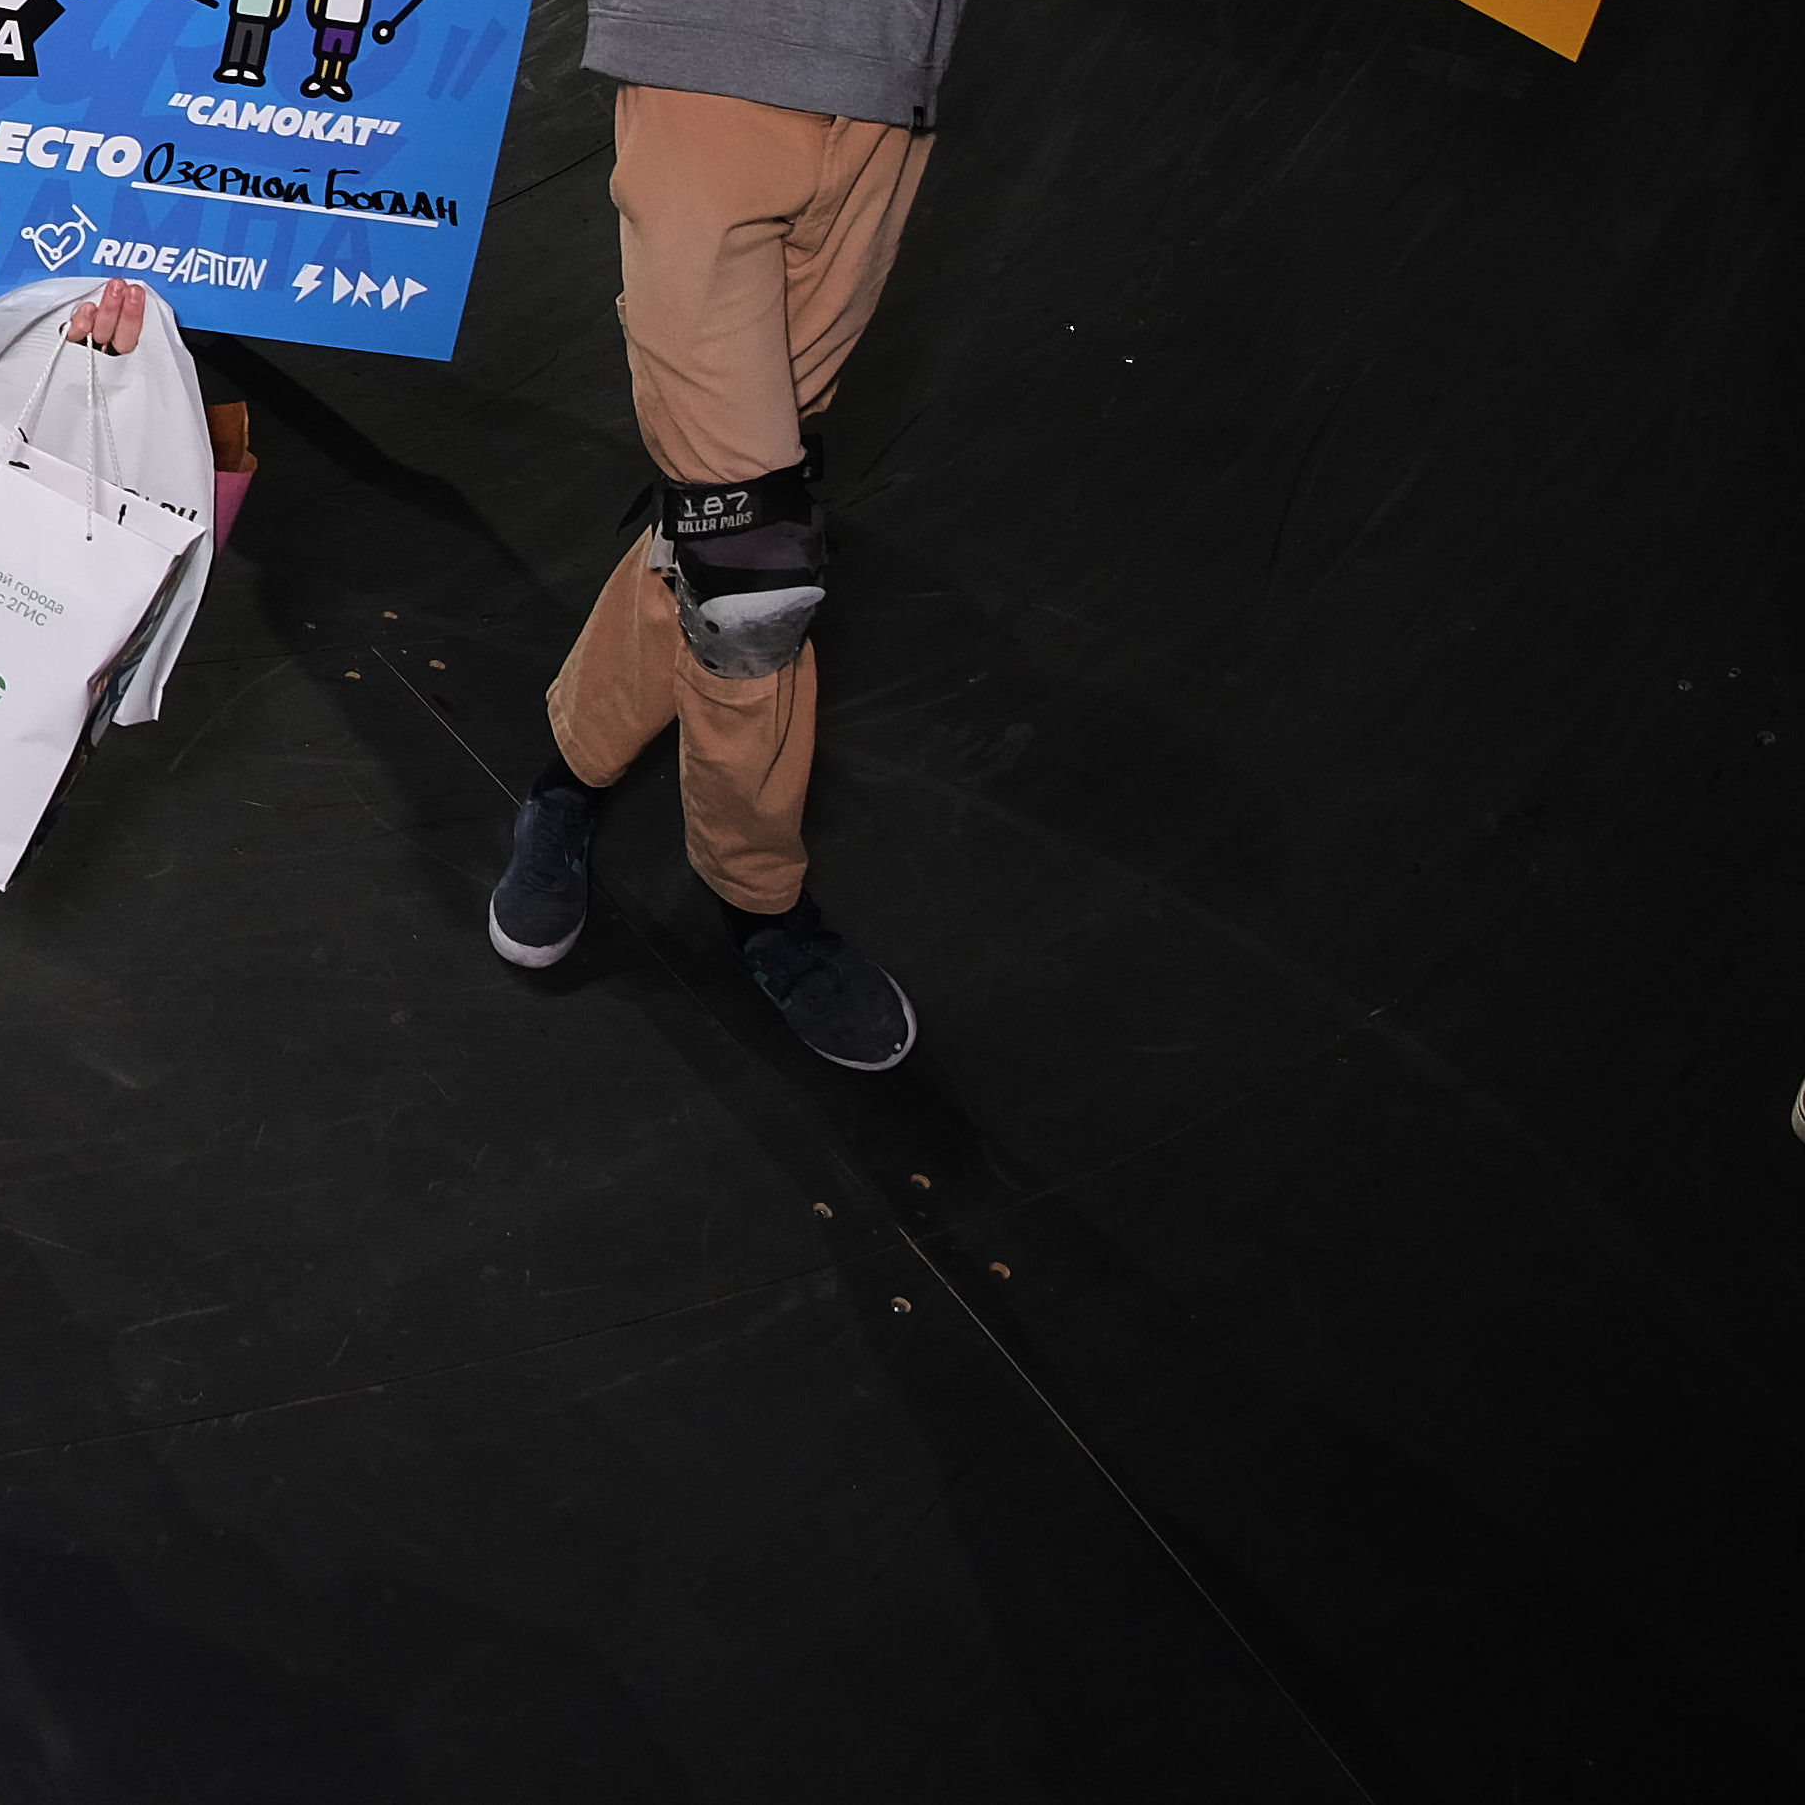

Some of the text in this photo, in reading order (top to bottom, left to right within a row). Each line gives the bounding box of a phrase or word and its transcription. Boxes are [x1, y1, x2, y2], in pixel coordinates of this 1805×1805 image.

[683, 491, 749, 518] 187
[677, 511, 754, 533] KILLER PADS
[6, 597, 47, 626] 2ГИС
[15, 581, 64, 615] города
